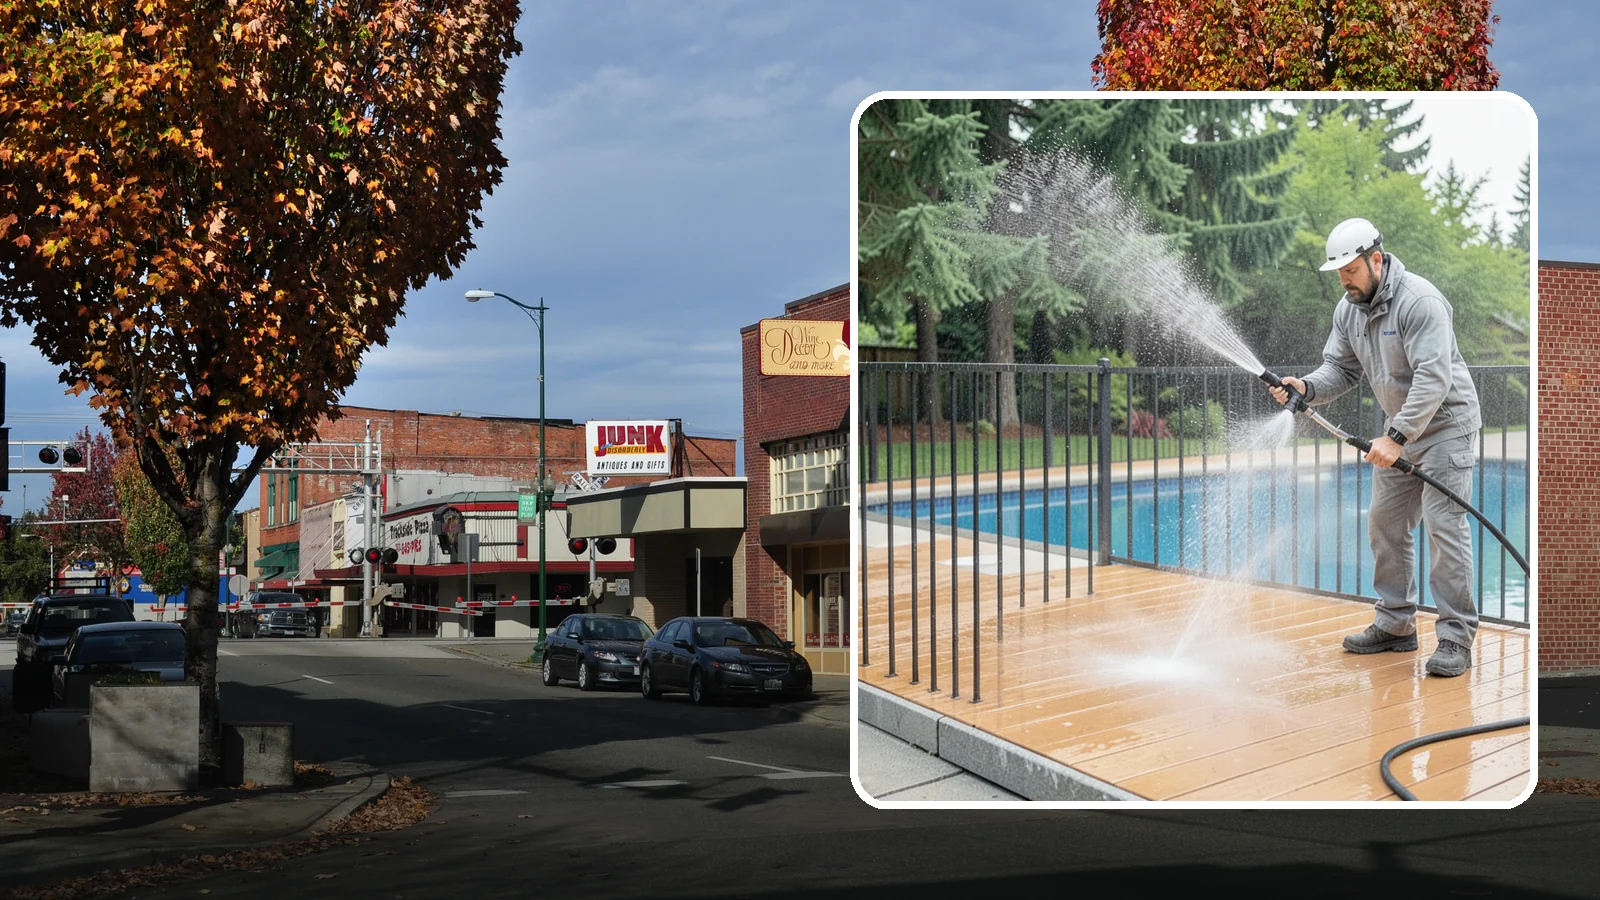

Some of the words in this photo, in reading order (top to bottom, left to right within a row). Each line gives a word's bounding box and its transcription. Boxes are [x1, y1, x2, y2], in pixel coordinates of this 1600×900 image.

[595, 425, 665, 457] JUNK
[597, 461, 628, 470] ANTIQUES
[631, 461, 643, 469] AND
[647, 460, 666, 469] GIFTS
[352, 498, 364, 511] CRO
[414, 520, 429, 535] Pizza
